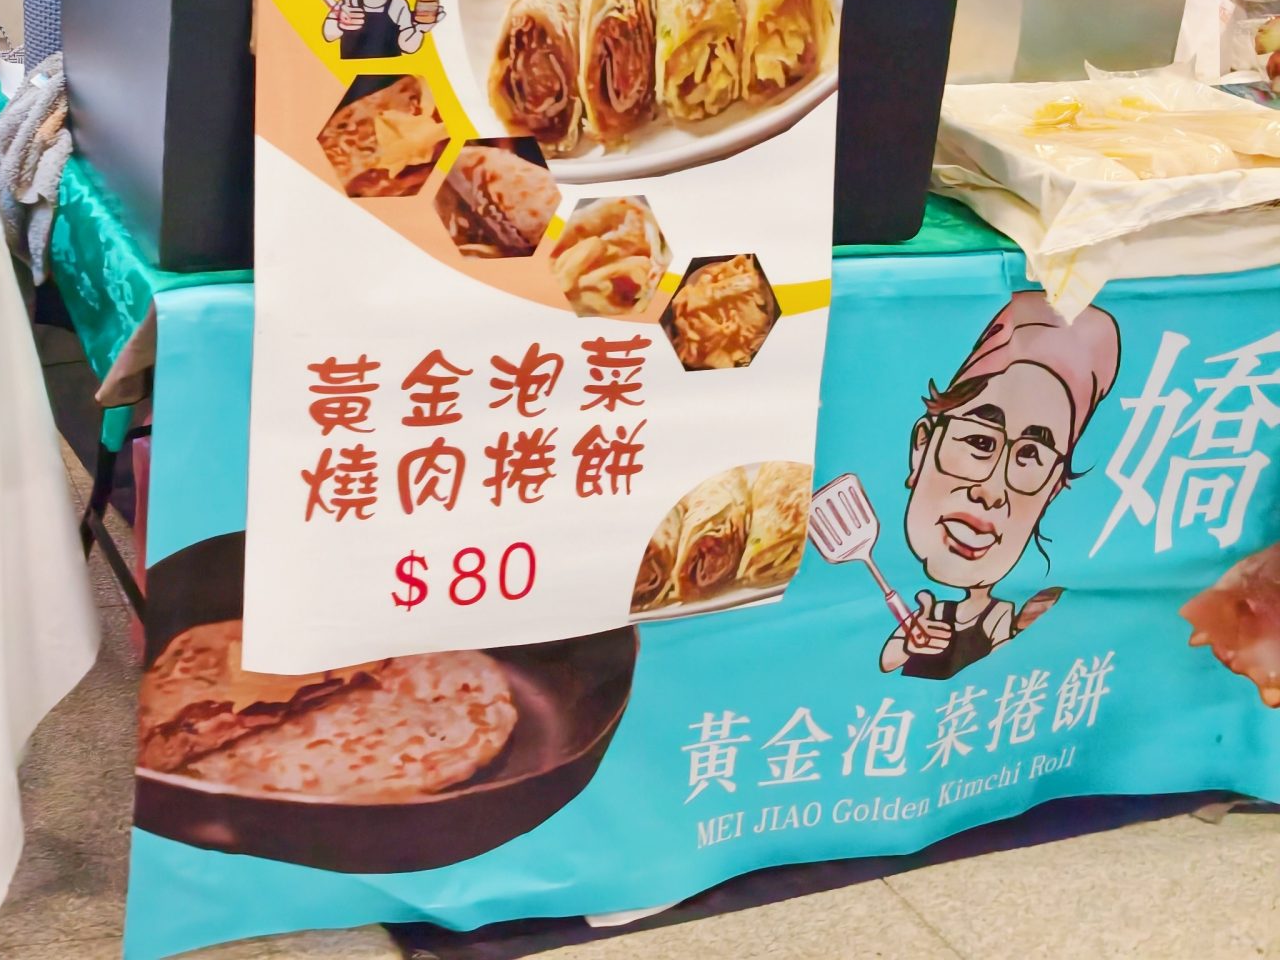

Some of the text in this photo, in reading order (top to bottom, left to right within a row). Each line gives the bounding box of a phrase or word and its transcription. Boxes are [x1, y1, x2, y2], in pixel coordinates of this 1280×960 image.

[307, 335, 652, 436] 黃金泡菜
[300, 419, 648, 522] 燒肉捲餅
[1088, 331, 1280, 559] 嬌
[391, 541, 537, 612] $80
[681, 650, 1116, 805] 黃金泡菜捲餅
[696, 746, 1077, 849] MEI JIAO Golden Kimchi Roll
